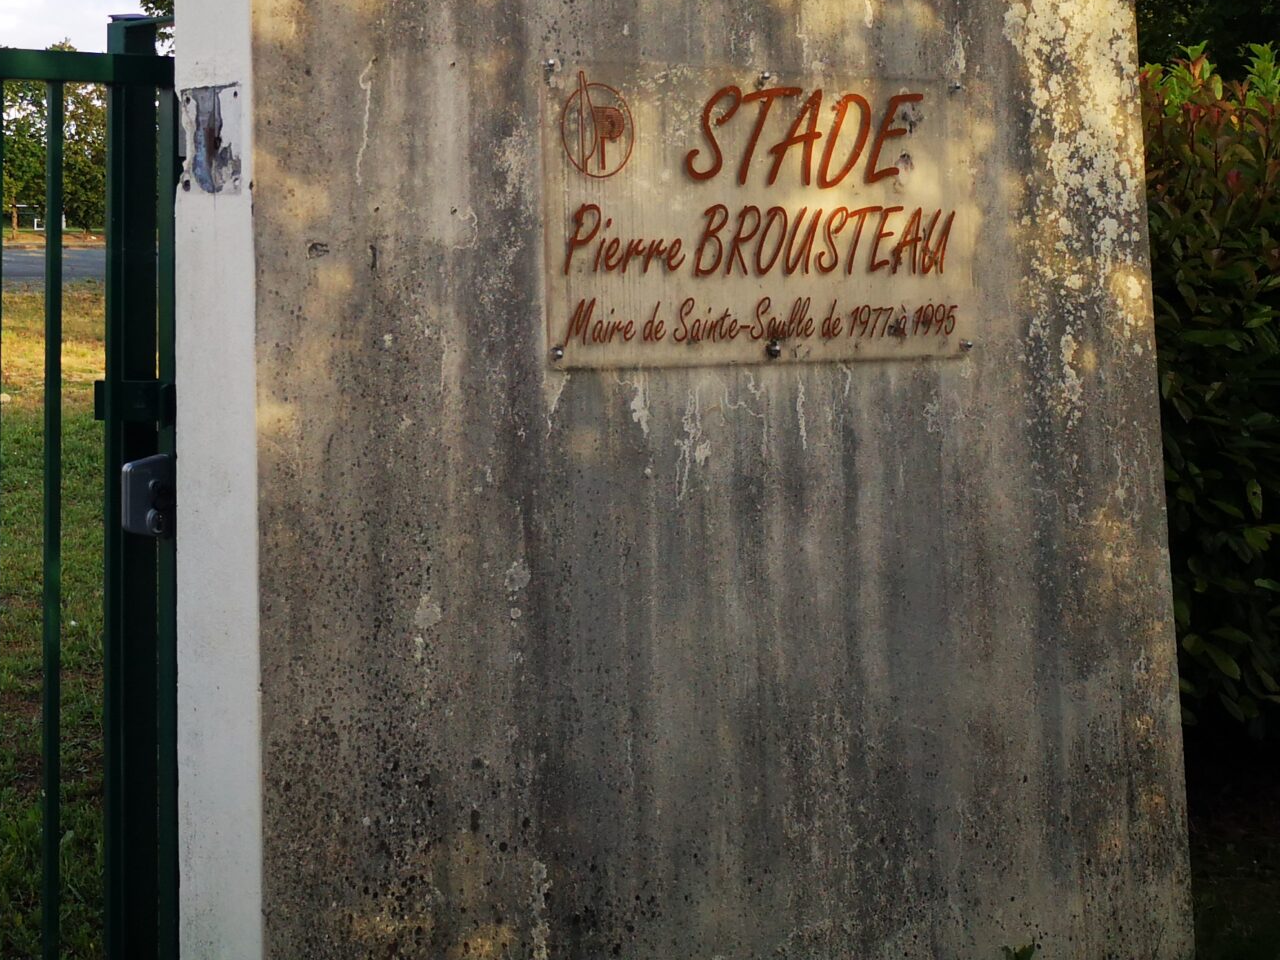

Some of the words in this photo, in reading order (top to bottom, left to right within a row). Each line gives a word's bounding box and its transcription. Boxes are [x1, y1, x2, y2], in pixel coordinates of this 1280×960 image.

[686, 85, 923, 189] STADE
[564, 204, 686, 276] Pierre
[694, 204, 956, 278] BROUSTEAU
[564, 297, 636, 347] Maire
[643, 301, 666, 342] de
[821, 299, 843, 338] de
[849, 304, 894, 337] 1977
[913, 303, 958, 336] 1995
